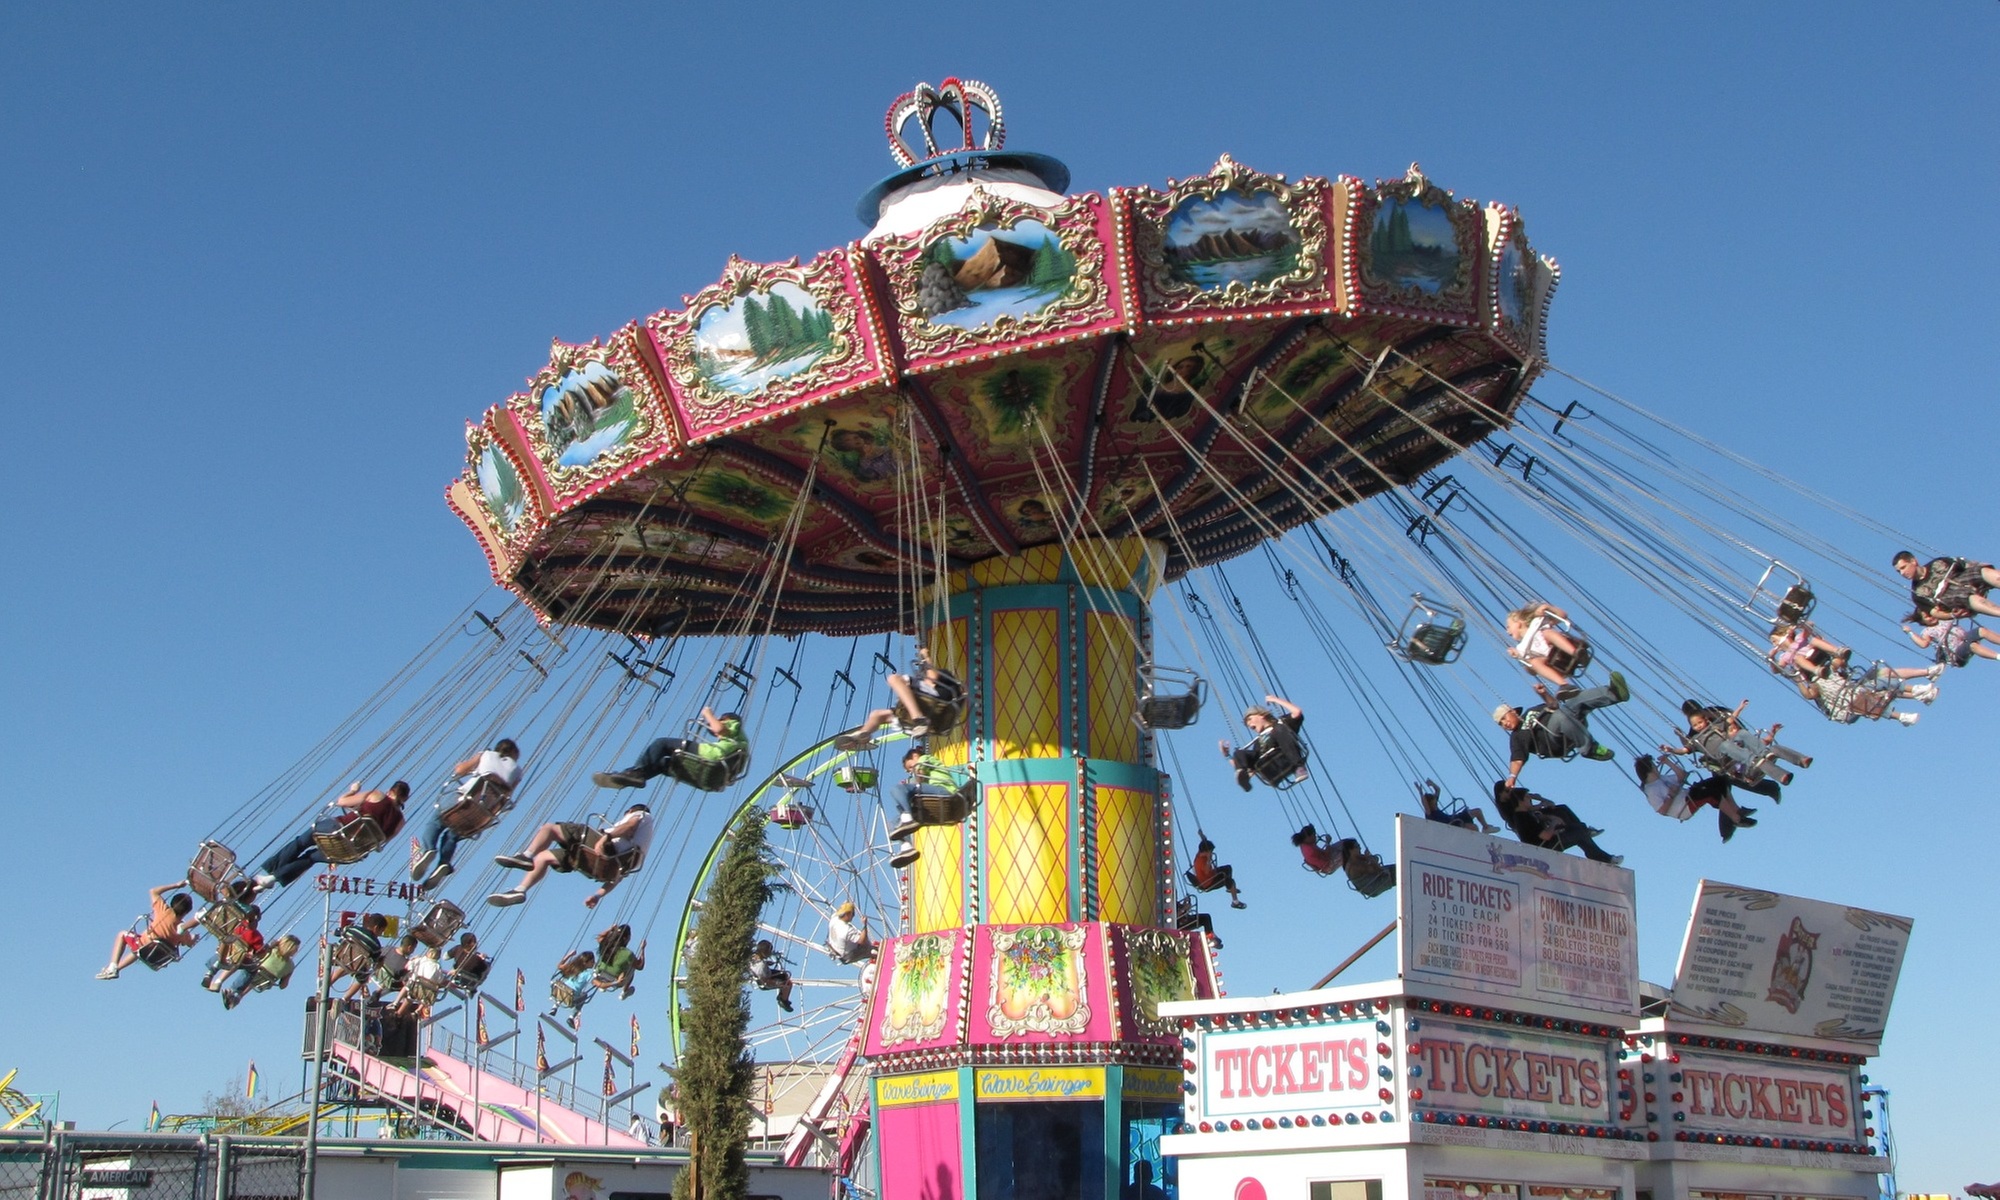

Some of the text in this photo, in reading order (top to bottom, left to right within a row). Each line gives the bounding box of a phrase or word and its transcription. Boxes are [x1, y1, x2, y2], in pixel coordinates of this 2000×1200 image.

[318, 875, 375, 896] STATE
[1423, 872, 1511, 911] RIDE TICKETS
[1473, 909, 1500, 922] EACH
[1540, 896, 1627, 936] CUPONES PARA RAITES
[1703, 918, 1730, 928] UNLIMITED
[1429, 914, 1508, 939] 24 TICKETS FOR $20
[1567, 927, 1587, 941] CADA
[1589, 932, 1619, 947] BOLETO
[1722, 931, 1742, 939] PERSON
[1428, 928, 1509, 951] 80 TICKETS FOR $50
[1543, 936, 1620, 959] 24 BOLETOS POR $20
[1714, 939, 1738, 948] COUPONS
[1543, 948, 1620, 972] 80 BOLETOS POR $50
[1697, 956, 1719, 964] COUPON
[1703, 947, 1727, 956] COUPONS
[1216, 1038, 1369, 1098] TICKETS
[1420, 1038, 1604, 1109] TICKETS
[1682, 1069, 1848, 1127] TICKETS
[1421, 1124, 1442, 1134] PLEASE
[1443, 1127, 1461, 1135] CHECK
[90, 1171, 147, 1182] AMERICAN
